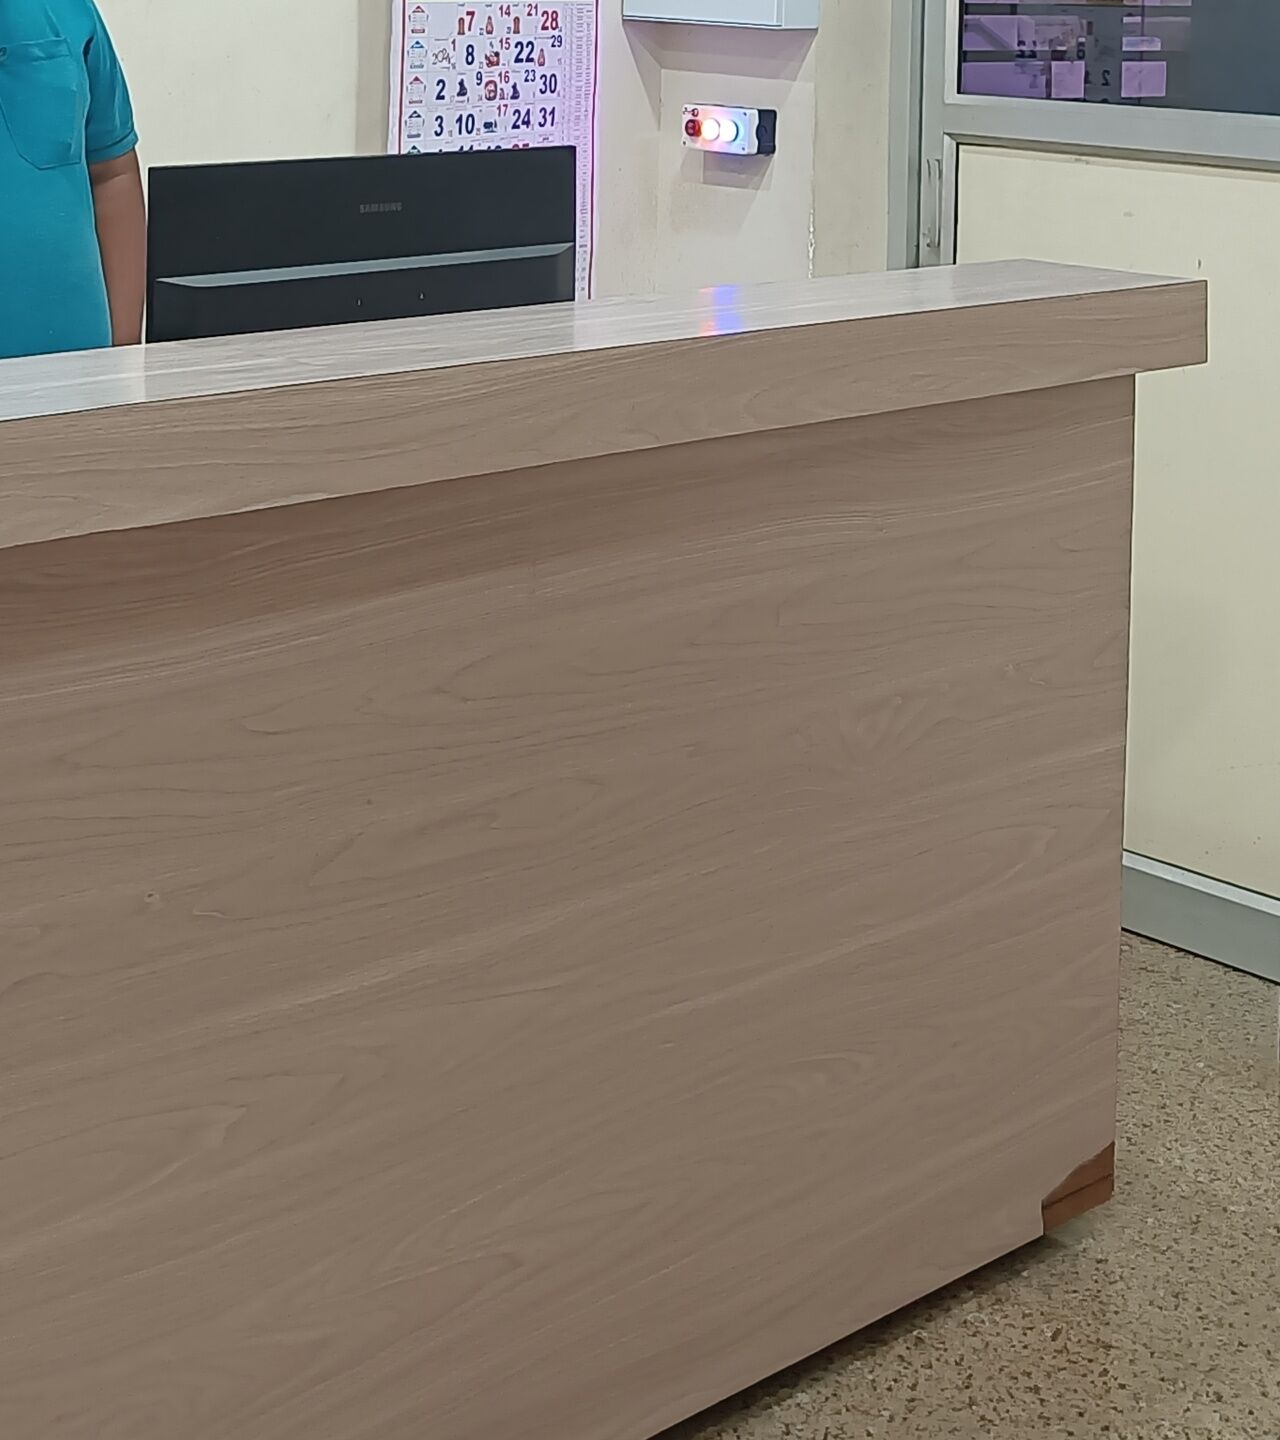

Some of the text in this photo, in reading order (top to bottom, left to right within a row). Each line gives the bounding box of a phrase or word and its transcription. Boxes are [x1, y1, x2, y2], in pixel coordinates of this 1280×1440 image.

[466, 3, 559, 32] 7 14 21 28
[451, 34, 563, 66] 1 8 15 22 29
[435, 69, 558, 100] 2 9 16 23 30
[434, 104, 556, 137] 3 10 17 24 31
